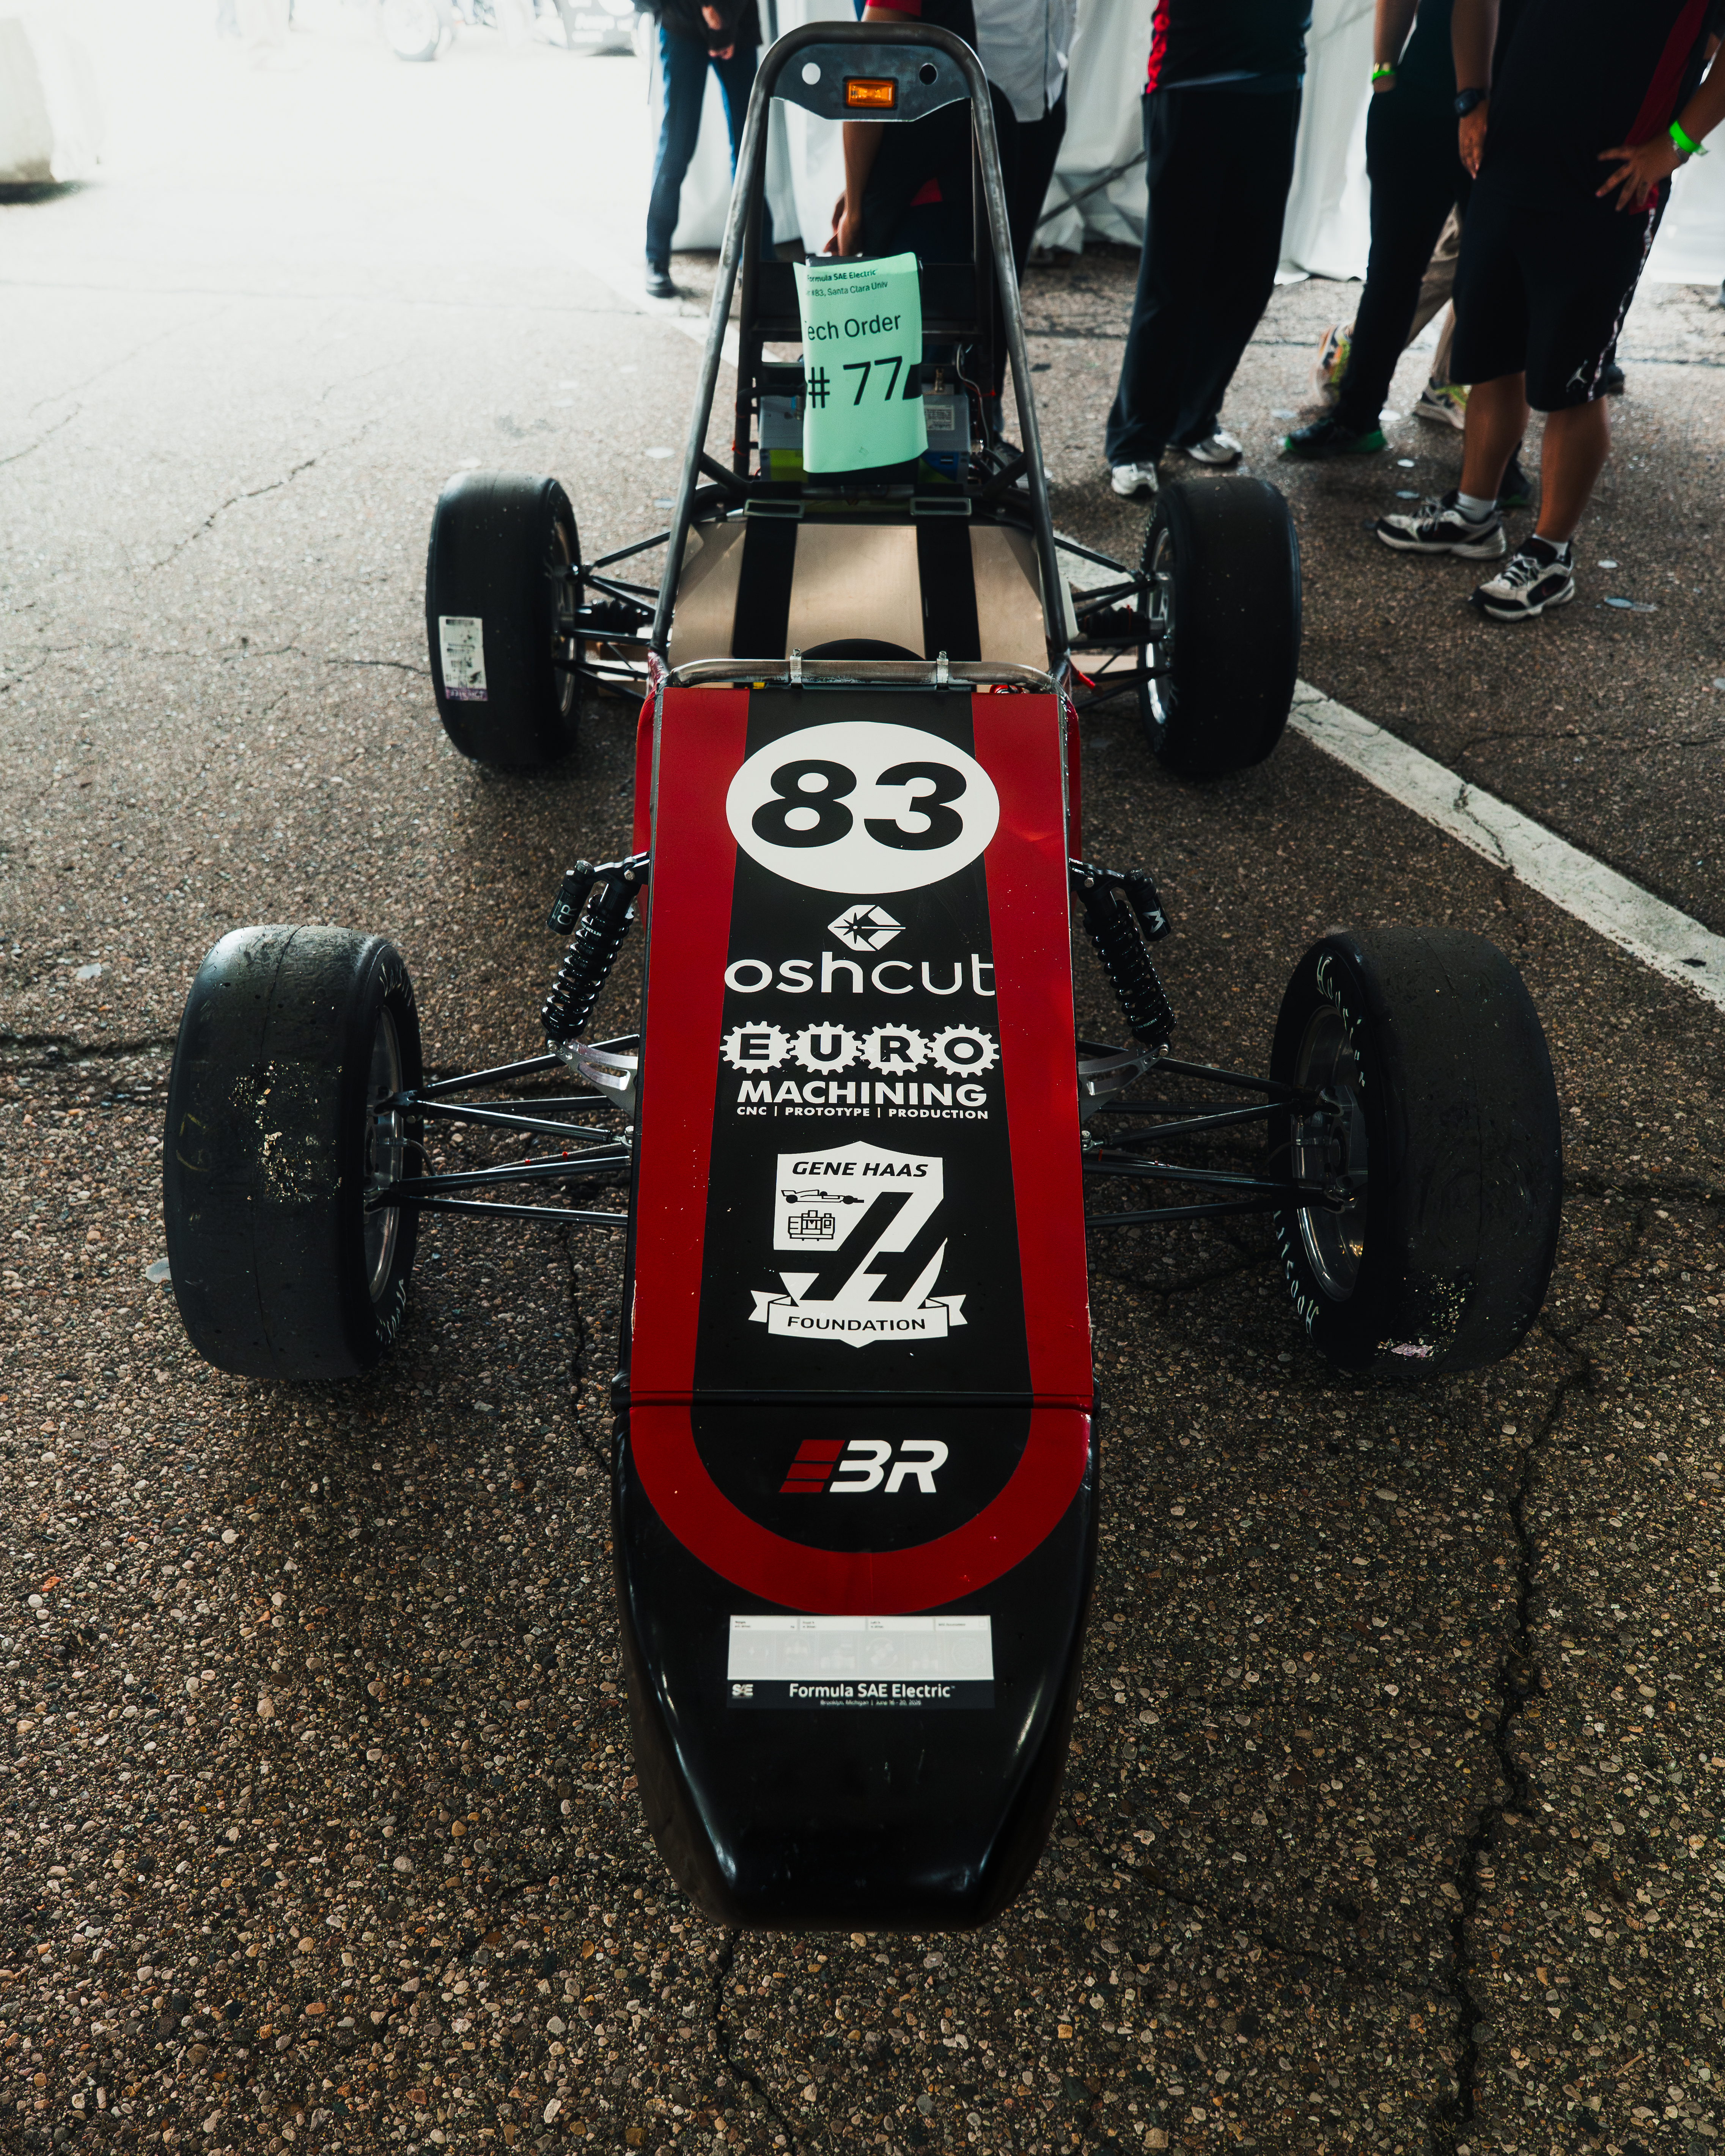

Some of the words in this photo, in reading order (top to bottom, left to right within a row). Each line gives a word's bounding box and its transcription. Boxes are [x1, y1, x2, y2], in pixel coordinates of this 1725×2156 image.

[849, 269, 876, 279] Electric
[850, 284, 870, 294] Clara
[871, 281, 888, 290] Univ
[805, 321, 839, 341] ech
[844, 314, 901, 338] Order
[808, 366, 830, 409] #
[843, 355, 903, 406] 77
[752, 759, 967, 851] 83
[724, 951, 995, 996] oshcut
[739, 1033, 984, 1065] EURO
[737, 1081, 987, 1106] MACHINING
[737, 1106, 767, 1115] CNC
[785, 1107, 870, 1117] PROTOTYPE
[889, 1108, 988, 1119] PRODUCTION
[792, 1161, 857, 1175] GENE
[862, 1163, 928, 1177] HAAS
[788, 1316, 925, 1331] FOUNDATION
[789, 1683, 853, 1697] Formula
[858, 1683, 888, 1697] SAE
[892, 1683, 950, 1697] Electric
